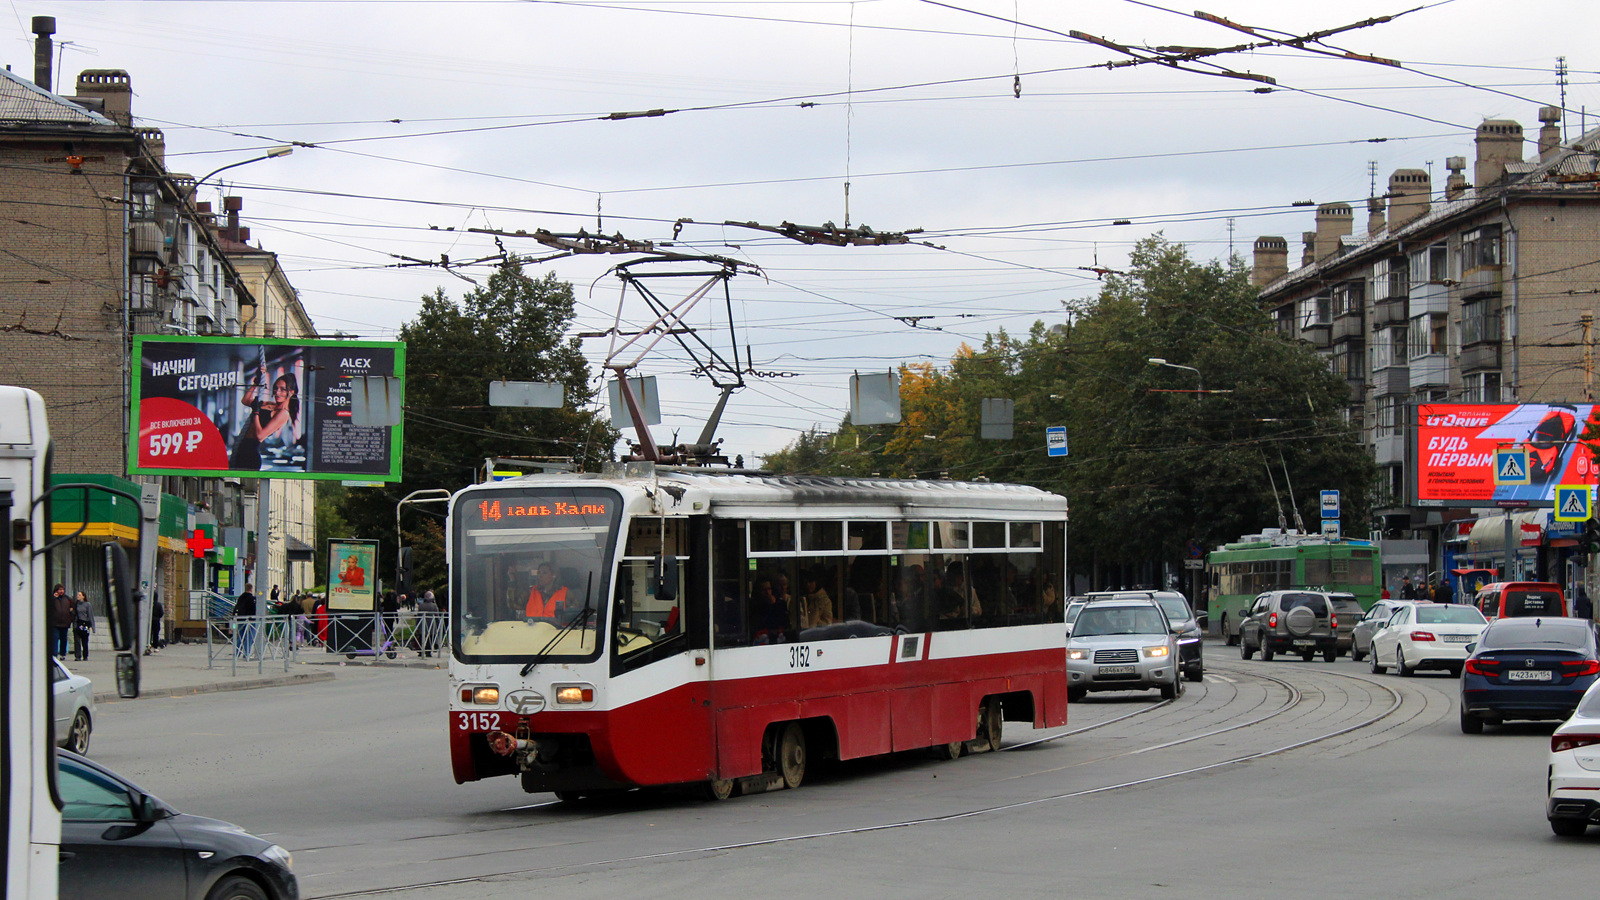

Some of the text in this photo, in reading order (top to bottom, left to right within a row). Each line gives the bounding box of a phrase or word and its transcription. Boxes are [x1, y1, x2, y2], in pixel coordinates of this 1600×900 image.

[152, 358, 196, 377] НАЧНИ
[340, 358, 371, 368] ALEX
[150, 417, 202, 429] ВСЕ ВКЛЮЧЕНО ЗА
[149, 432, 183, 456] 599
[1427, 436, 1469, 452] БУДЬ
[1427, 453, 1494, 467] ПЕРВЫМ
[478, 500, 502, 521] 14
[789, 645, 810, 668] 3152
[458, 712, 501, 730] 3152
